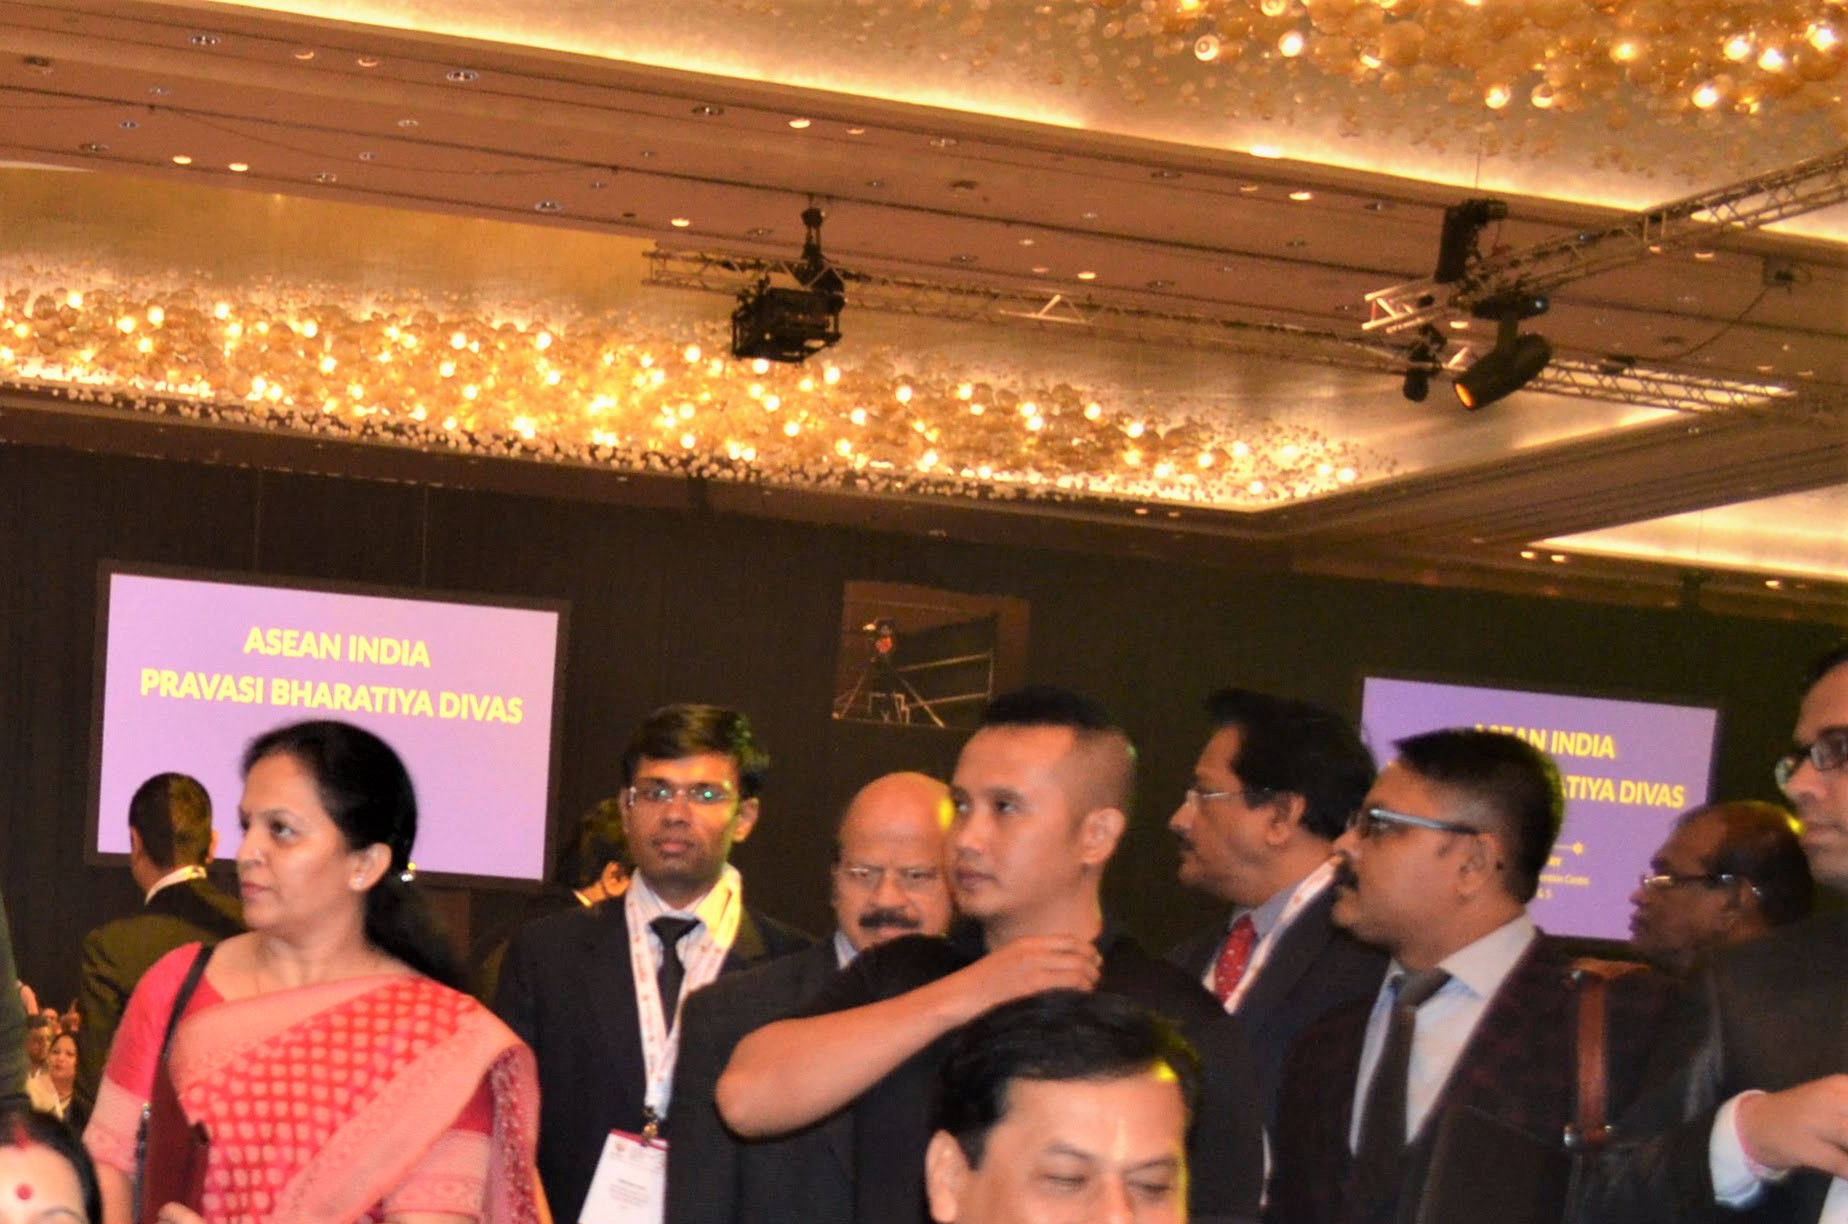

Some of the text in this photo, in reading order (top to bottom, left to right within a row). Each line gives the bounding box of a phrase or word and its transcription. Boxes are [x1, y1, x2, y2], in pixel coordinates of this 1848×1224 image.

[243, 626, 431, 668] ASEAN INDIA
[140, 668, 524, 724] PRAVASI BHARATIYA DIVAS
[1551, 730, 1616, 760] INDIA
[1619, 779, 1686, 809] DIVAS
